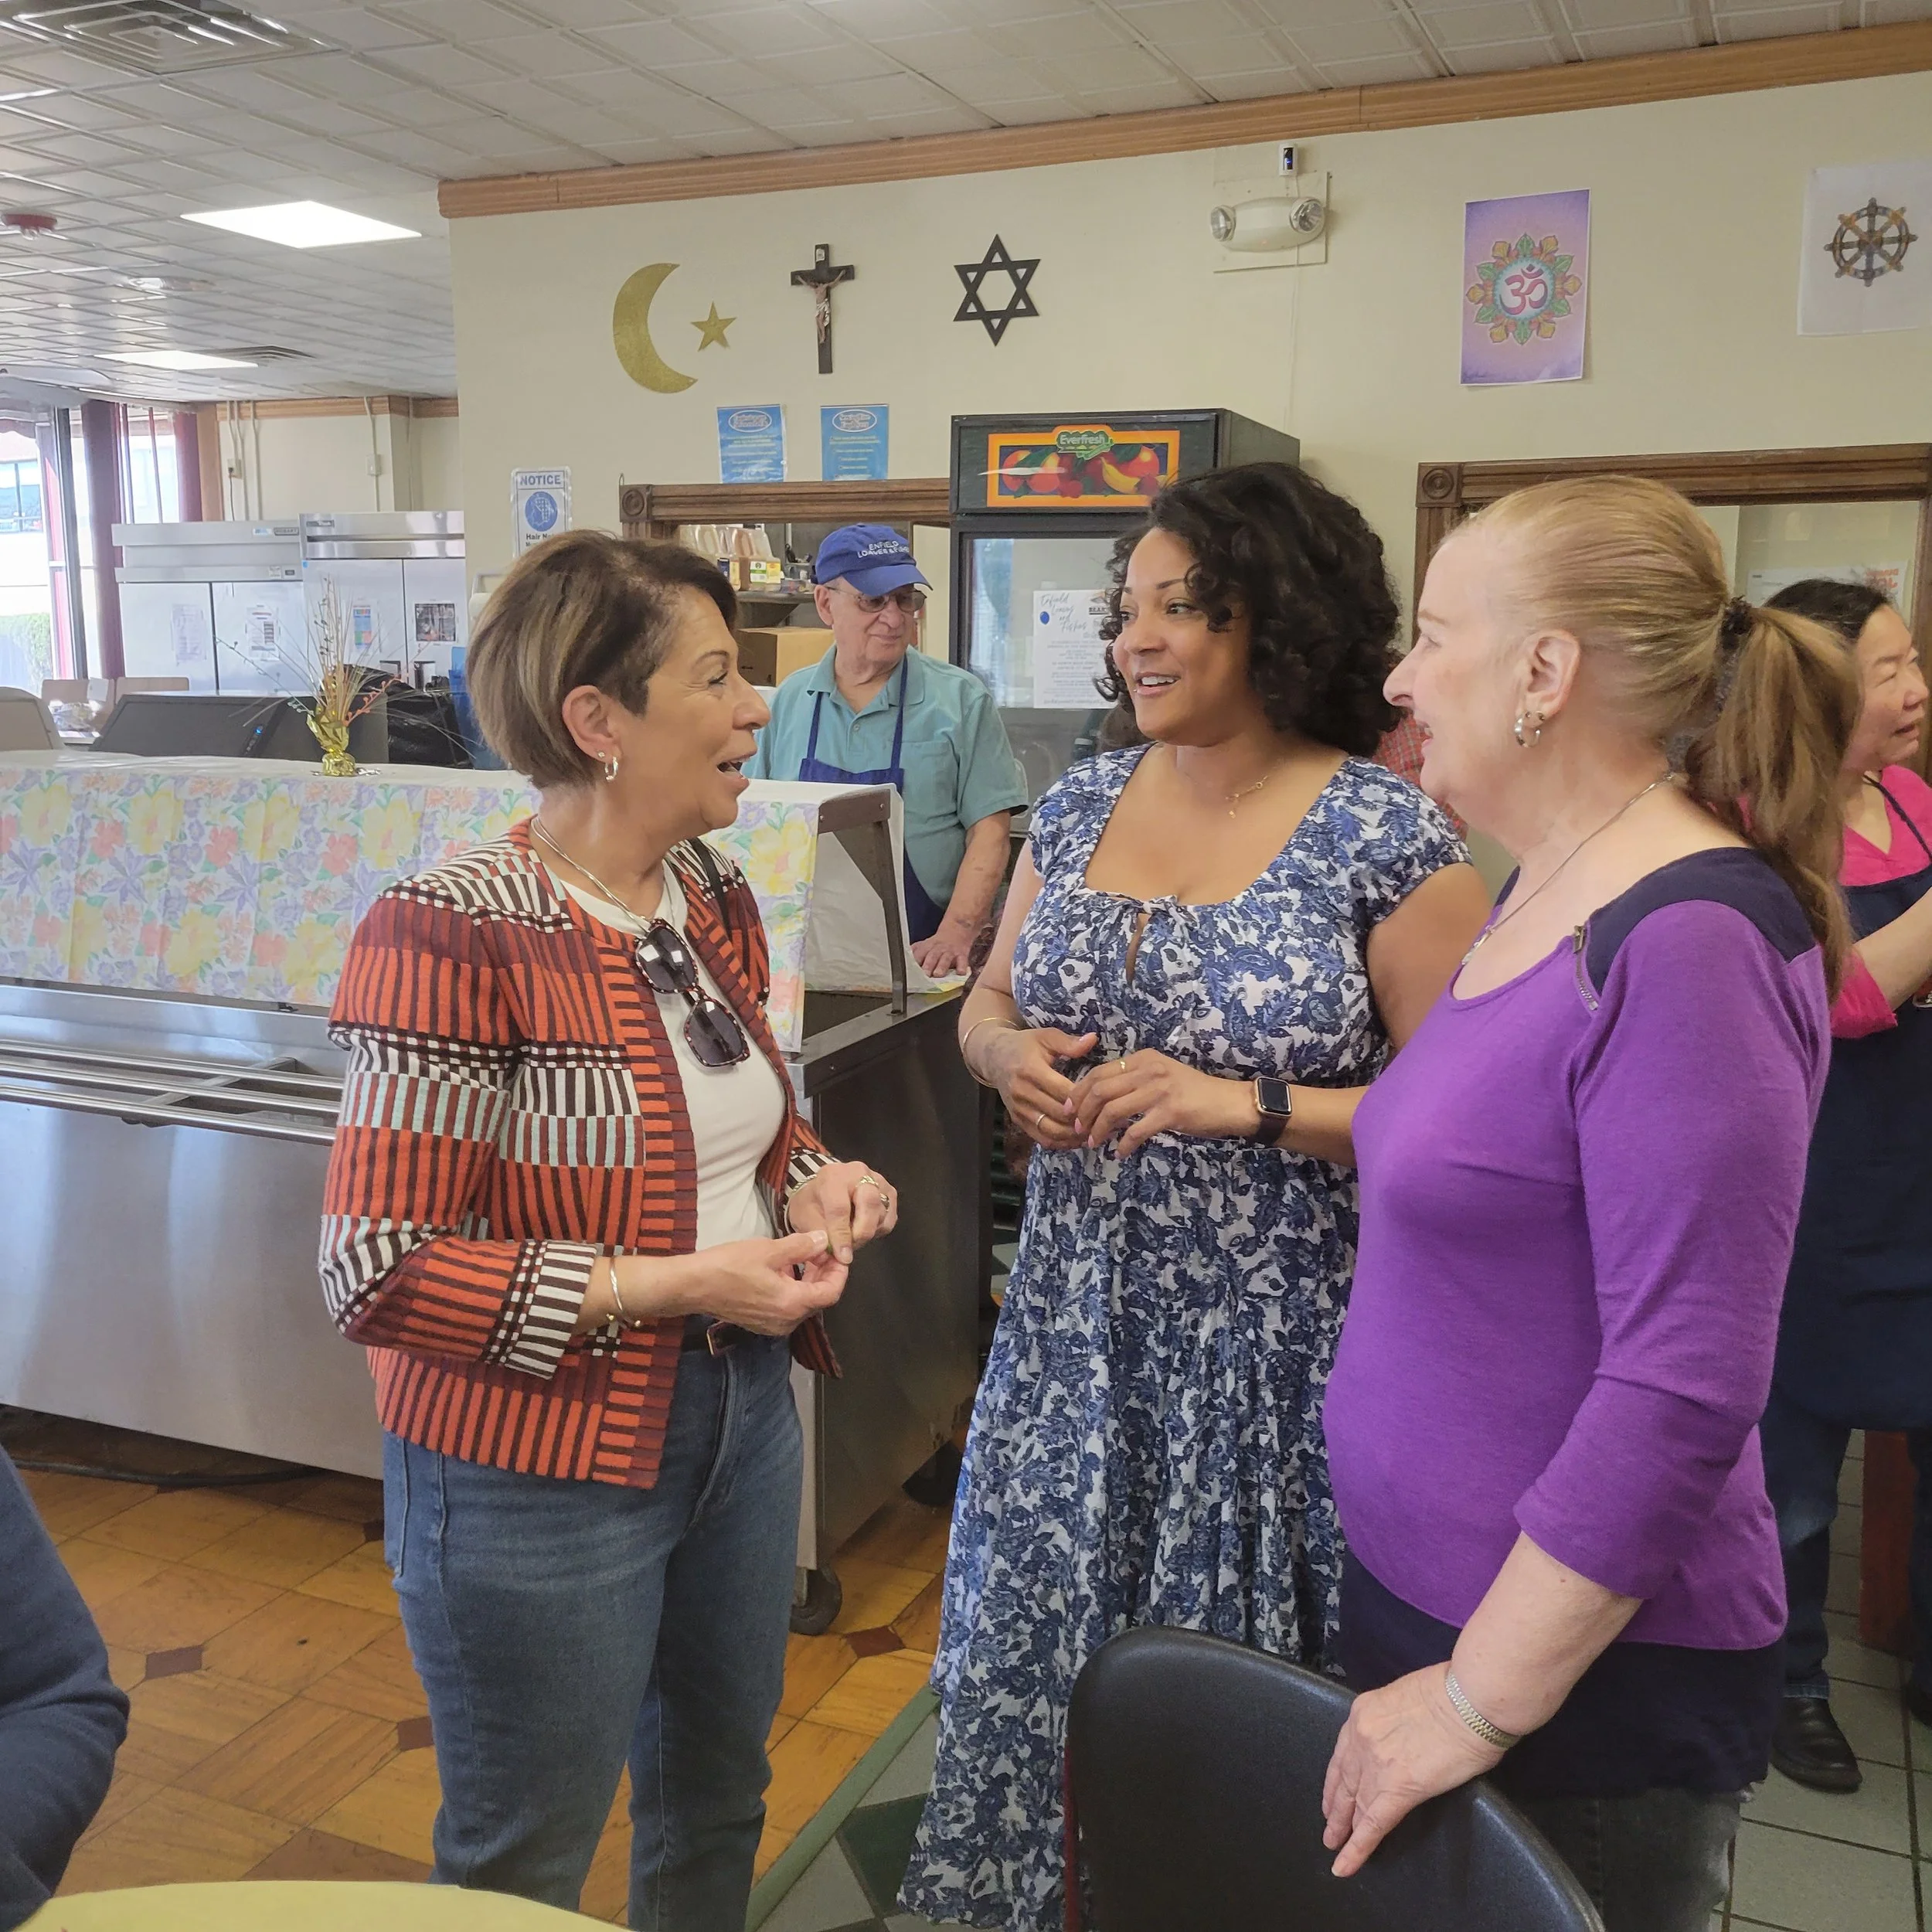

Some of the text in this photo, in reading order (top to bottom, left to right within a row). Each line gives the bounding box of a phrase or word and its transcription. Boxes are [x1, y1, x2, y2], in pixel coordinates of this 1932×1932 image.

[1060, 434, 1105, 444] Everfresh
[520, 474, 561, 485] NOTICE
[869, 540, 900, 551] ENFIELD
[857, 549, 888, 558] LOAVES
